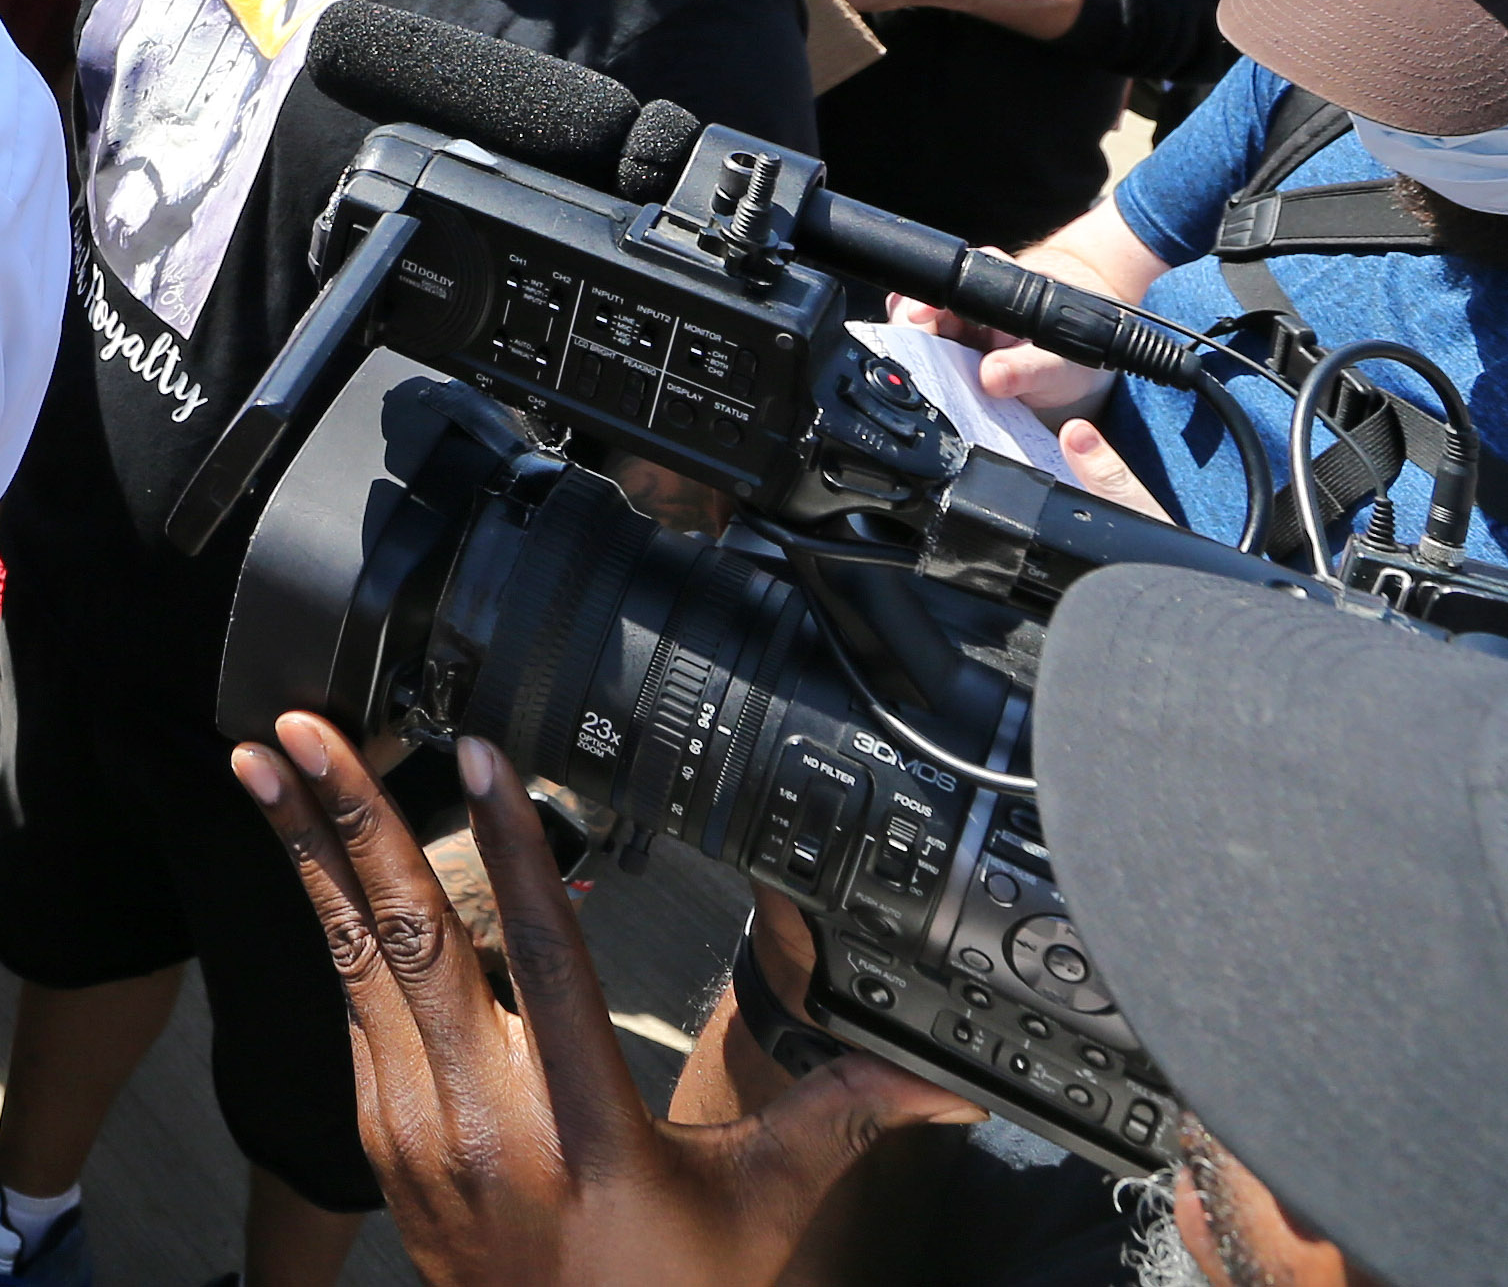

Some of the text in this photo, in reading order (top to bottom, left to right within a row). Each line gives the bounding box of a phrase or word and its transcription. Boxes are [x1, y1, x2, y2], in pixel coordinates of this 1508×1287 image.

[509, 254, 528, 266] CH1
[418, 266, 455, 288] DOLBY
[552, 271, 572, 285] CH2
[591, 287, 625, 305] INPUT1
[618, 313, 635, 325] LINE
[636, 304, 672, 324] INPUT2
[615, 329, 631, 340] MIC
[683, 322, 722, 342] MONITOR
[84, 262, 210, 423] Royalty
[574, 337, 617, 360] LCD BRIGHT
[709, 358, 729, 371] BOTH
[712, 350, 728, 361] CH1
[622, 357, 657, 377] PEAKING
[707, 365, 725, 378] CH2
[475, 372, 493, 386] CH1
[527, 394, 547, 407] CH2
[666, 382, 704, 403] DISPLAY
[714, 401, 750, 422] STATUS
[581, 711, 622, 747] 23x
[576, 740, 606, 759] ZOOM
[578, 731, 617, 757] OPTICAL
[688, 738, 704, 756] 60
[681, 765, 695, 781] 40
[802, 753, 857, 788] ND FILTER
[892, 791, 933, 818] FOCUS
[925, 835, 947, 852] AUTO
[855, 890, 902, 919] PUSH AUTO
[858, 959, 907, 988] PUSH AUTO
